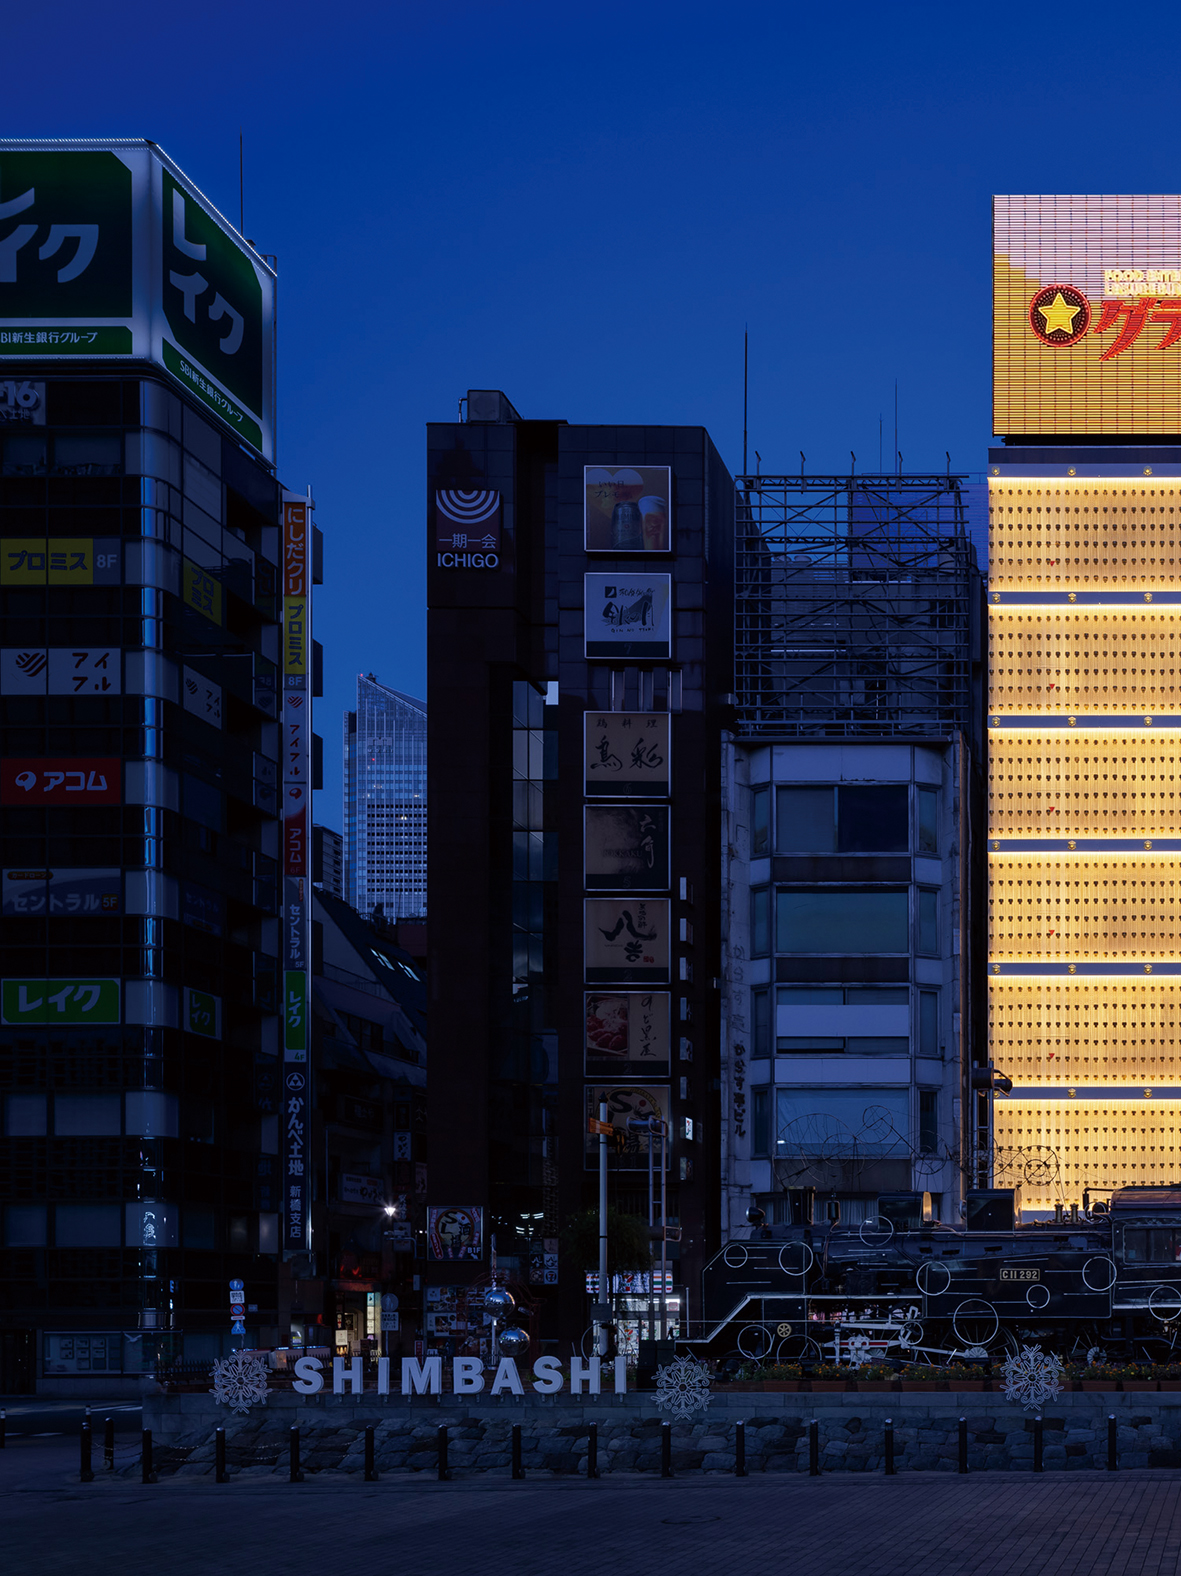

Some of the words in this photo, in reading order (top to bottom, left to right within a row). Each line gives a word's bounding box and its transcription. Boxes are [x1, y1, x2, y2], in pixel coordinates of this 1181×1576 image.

[1105, 269, 1145, 282] FOOD
[0, 331, 98, 344] BI新生銀行グループ
[179, 359, 244, 422] SBI新生銀行グループ
[439, 533, 497, 550] 一期一会
[8, 550, 88, 571] プロミス
[96, 555, 118, 568] 8F
[437, 553, 499, 568] ICHIGO
[288, 604, 304, 666] プロミス
[288, 676, 303, 686] 8F
[289, 724, 301, 776] アイフル
[43, 769, 108, 792] アコム
[289, 828, 302, 864] アコム
[13, 894, 99, 912] セントラル
[103, 896, 118, 909] 5F
[289, 903, 301, 960] セントラル
[18, 985, 101, 1012] レイク
[288, 991, 302, 1028] レイク
[287, 1097, 305, 1176] かんべ土地
[290, 1185, 302, 1239] 新橋支店
[1019, 1270, 1038, 1279] 292
[292, 1355, 627, 1396] SHIMBASHI
